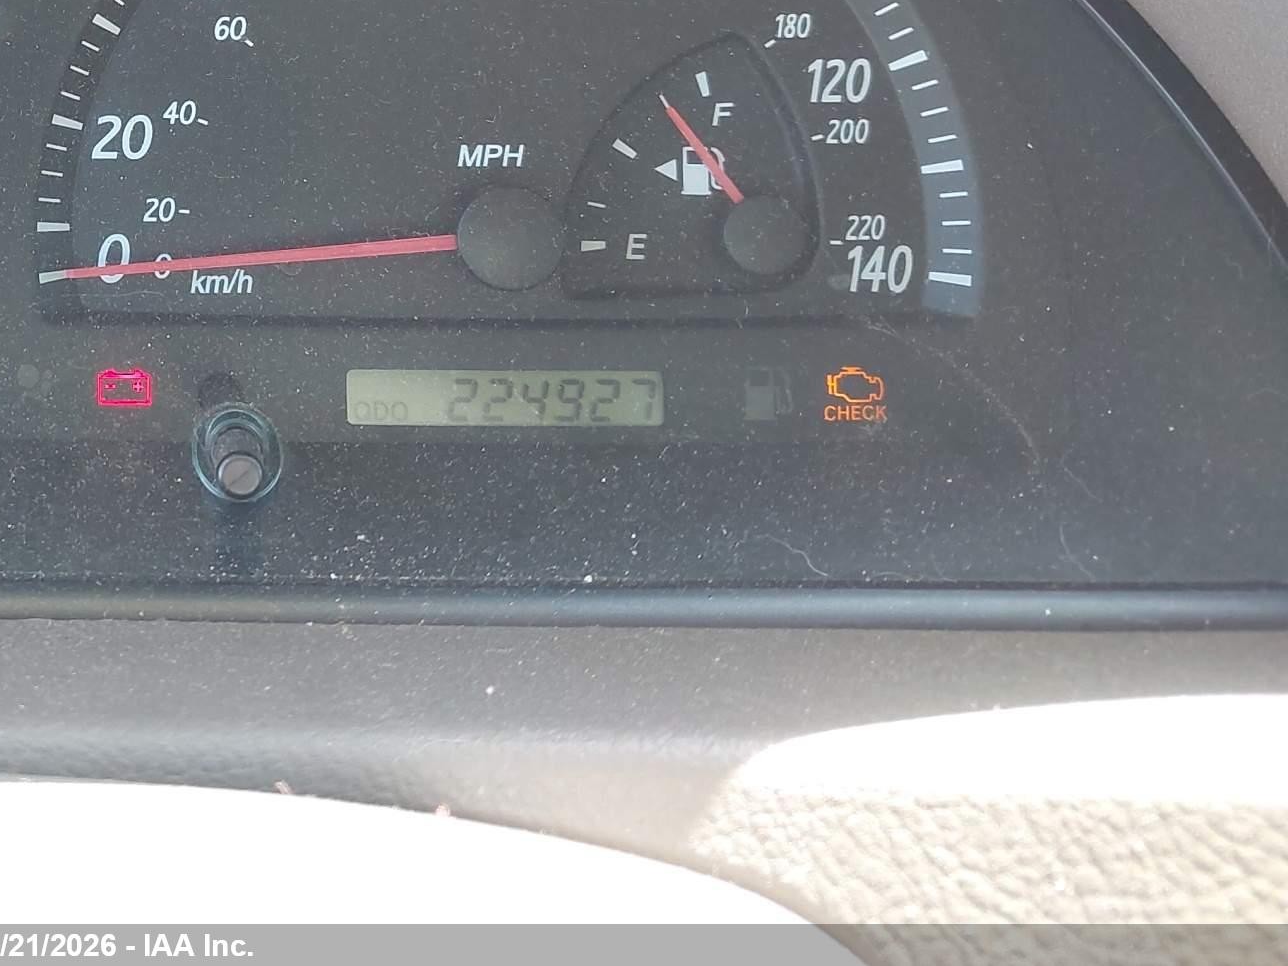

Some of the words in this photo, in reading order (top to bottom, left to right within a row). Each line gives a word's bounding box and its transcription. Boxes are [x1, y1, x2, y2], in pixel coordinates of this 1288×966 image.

[214, 16, 246, 40] 60
[775, 14, 810, 38] 180
[808, 59, 869, 103] 120
[163, 101, 196, 125] 40
[713, 102, 734, 126] F
[92, 115, 152, 159] 20
[826, 120, 868, 143] 200
[457, 144, 524, 167] MPH
[143, 198, 174, 222] 20
[845, 216, 884, 239] 220
[98, 234, 130, 284] 0
[627, 235, 646, 259] E
[154, 253, 172, 279] 0
[848, 246, 912, 293] 140
[190, 269, 253, 294] km/h
[354, 401, 408, 421] ODO
[447, 379, 656, 422] 224927
[824, 404, 887, 422] CHECK
